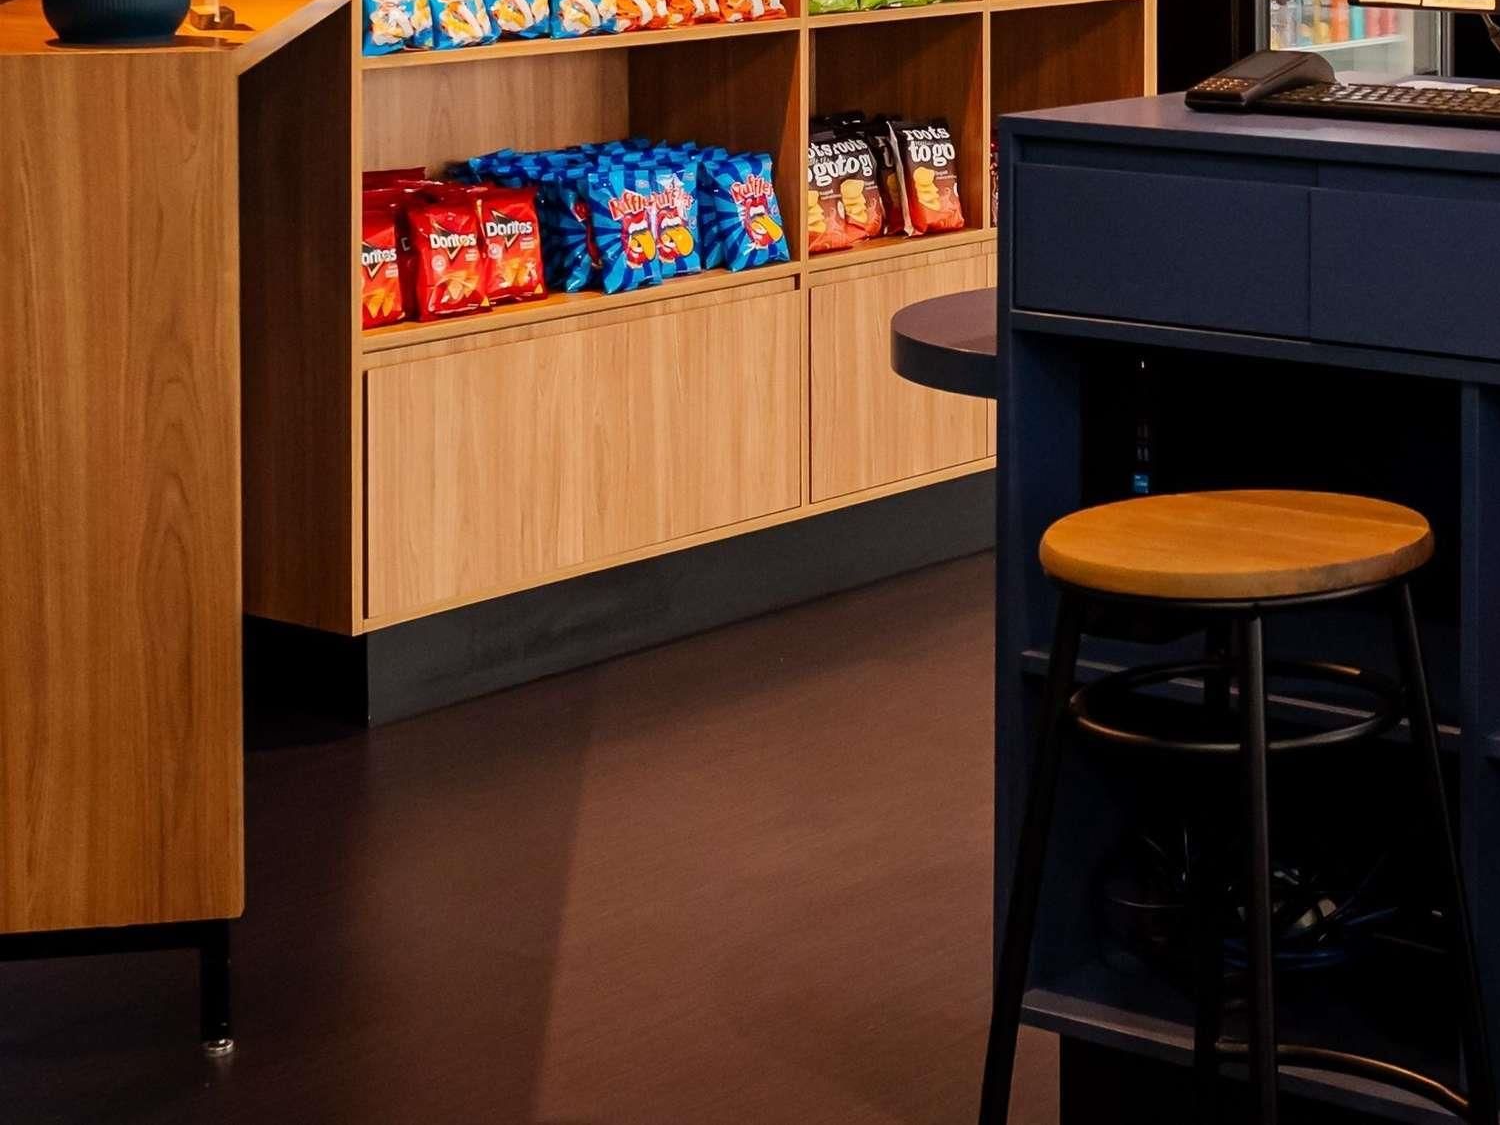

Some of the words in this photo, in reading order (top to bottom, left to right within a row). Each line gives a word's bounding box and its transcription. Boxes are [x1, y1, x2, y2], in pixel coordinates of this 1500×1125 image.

[902, 126, 951, 142] roots
[833, 138, 868, 156] roots
[909, 141, 931, 163] to
[932, 142, 956, 167] go
[836, 154, 860, 176] to
[485, 221, 533, 238] Doritos
[430, 232, 477, 250] Doritos
[362, 247, 398, 266] oritos
